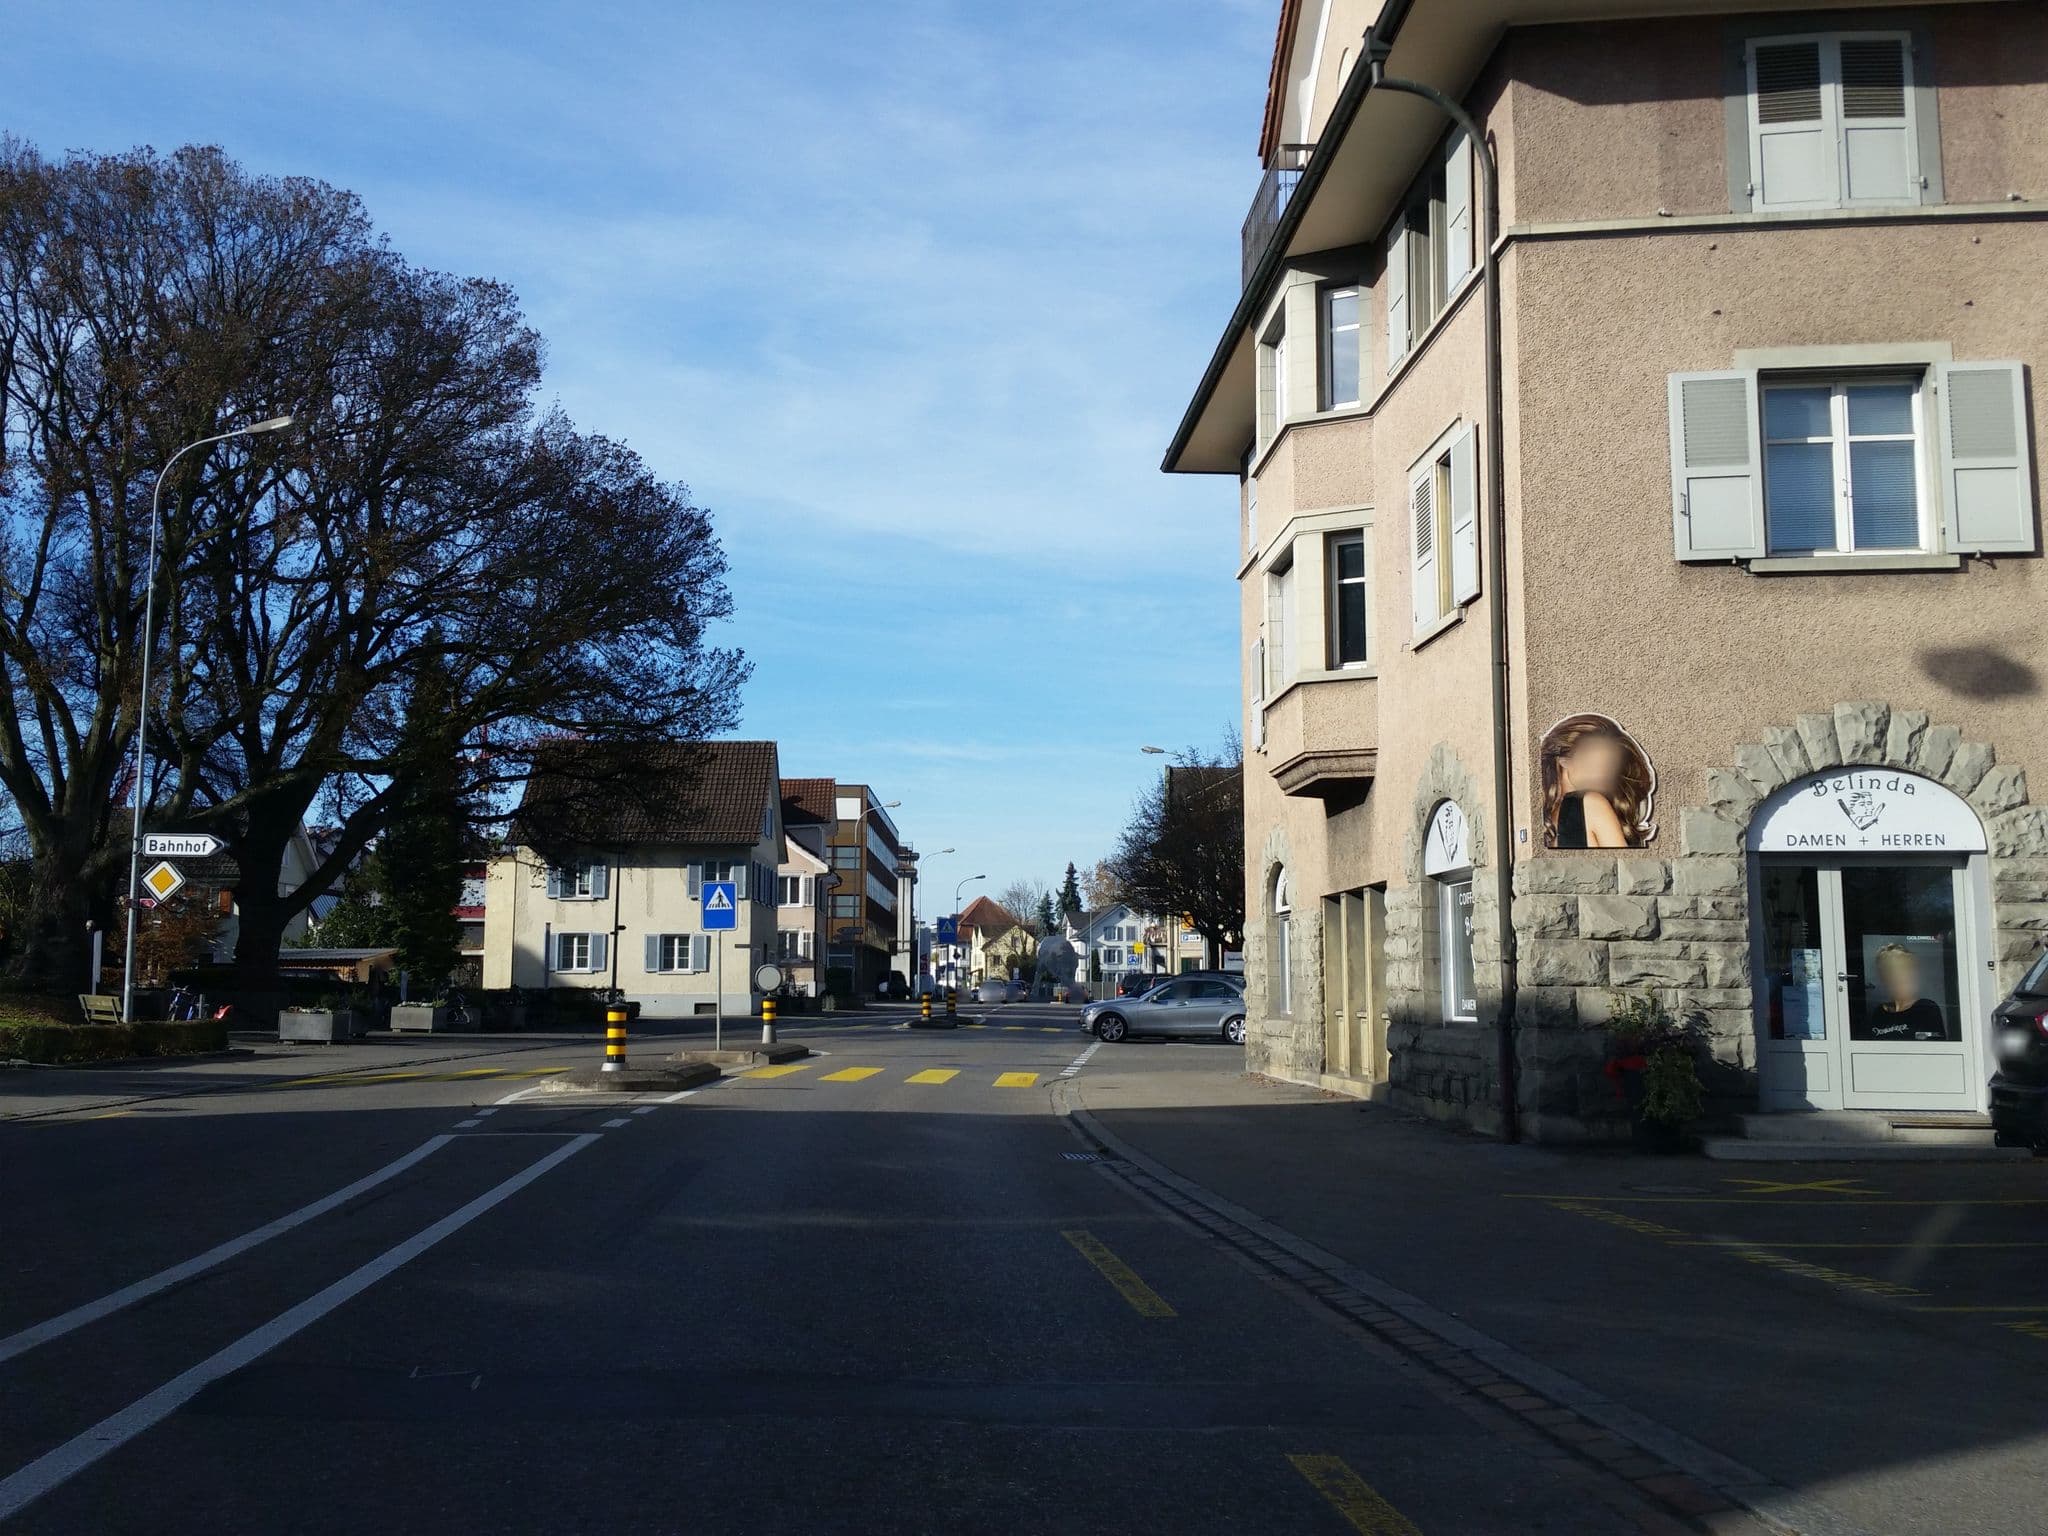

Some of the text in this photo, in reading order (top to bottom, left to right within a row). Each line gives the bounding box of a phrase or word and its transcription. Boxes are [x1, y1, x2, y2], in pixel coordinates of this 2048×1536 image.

[1809, 775, 1916, 797] Belinda
[149, 839, 208, 852] Bahnhof
[1786, 834, 1846, 847] DAMEN
[1881, 834, 1945, 847] HERREN
